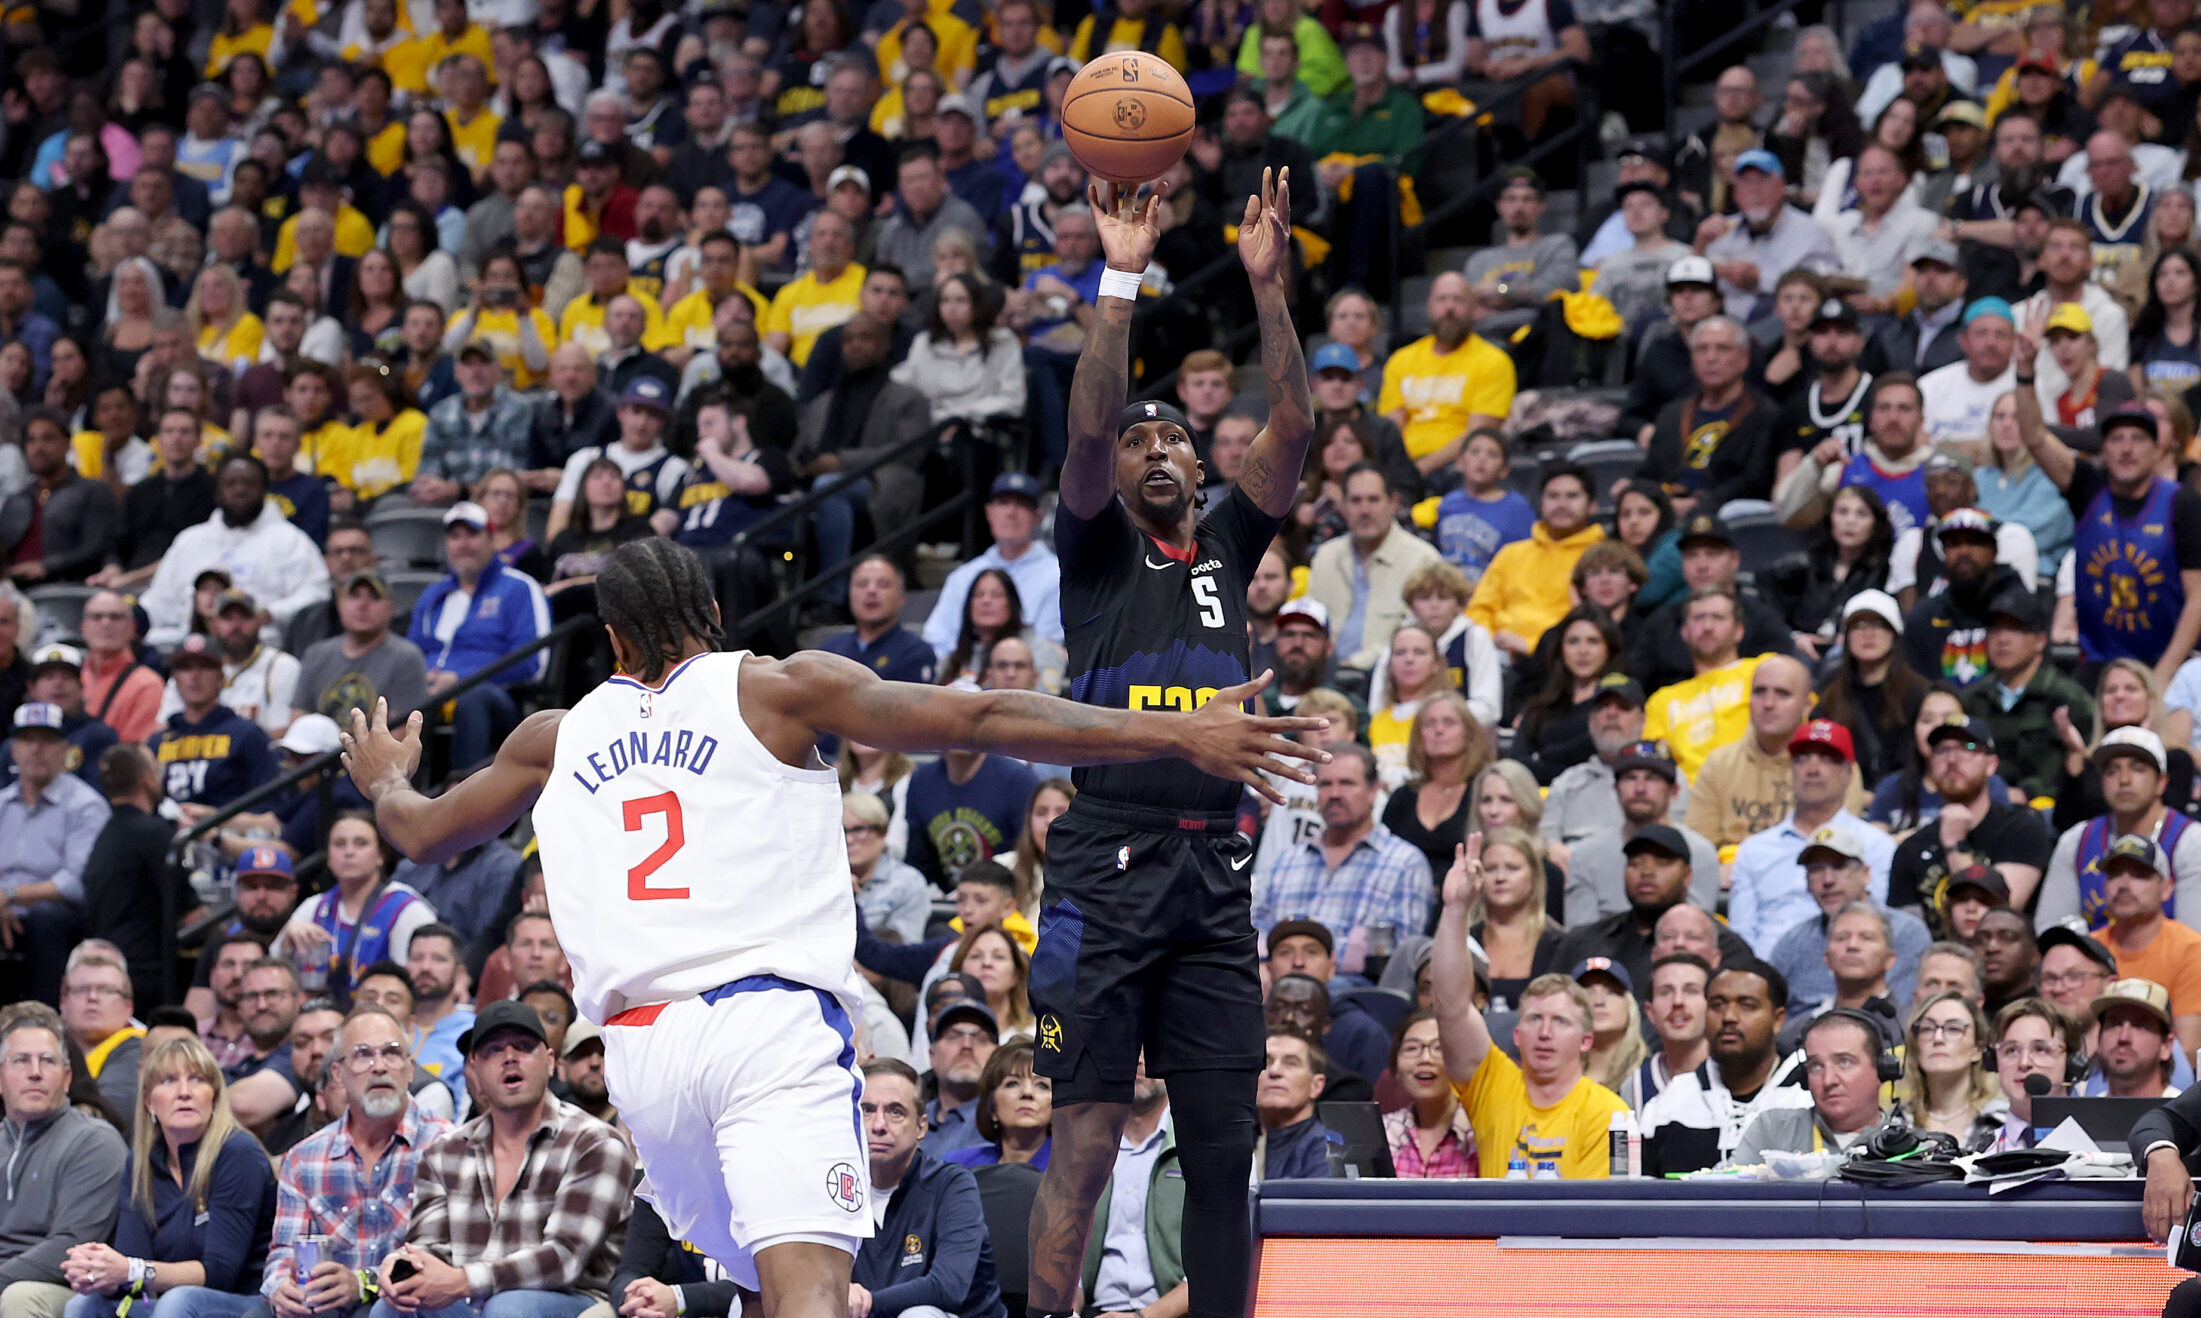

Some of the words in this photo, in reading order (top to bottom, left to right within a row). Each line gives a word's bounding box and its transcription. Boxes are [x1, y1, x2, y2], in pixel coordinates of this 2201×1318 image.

[1190, 575, 1226, 629] 5
[573, 729, 719, 795] LEONARD
[621, 790, 690, 901] 2
[1178, 818, 1208, 831] DENVER
